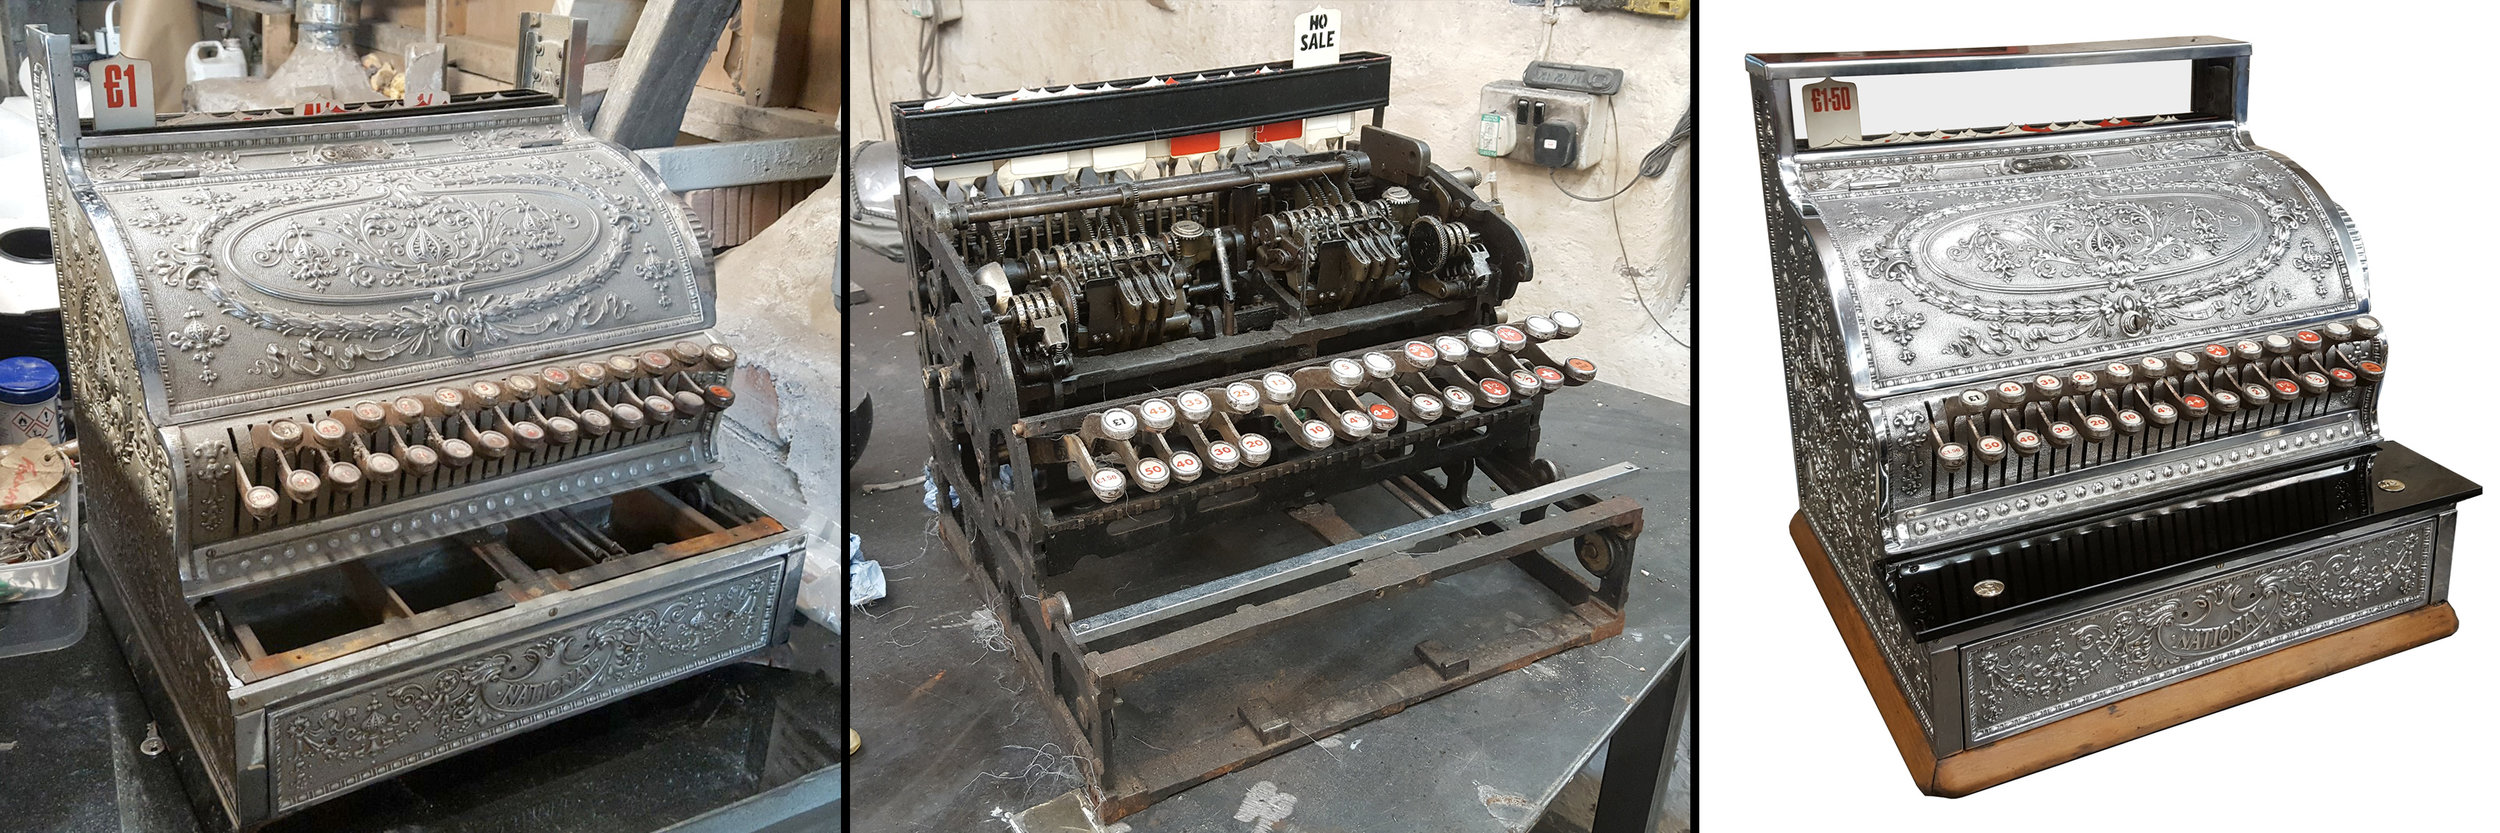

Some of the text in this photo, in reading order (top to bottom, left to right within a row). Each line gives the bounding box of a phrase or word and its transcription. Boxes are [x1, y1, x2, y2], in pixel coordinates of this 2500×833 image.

[1309, 14, 1328, 31] NO
[1300, 30, 1335, 51] SALE
[104, 64, 137, 108] £1
[1341, 363, 1350, 371] 5
[2074, 372, 2090, 381] 25
[1271, 378, 1287, 386] 15
[2039, 378, 2055, 386] 35
[1233, 389, 1250, 398] 25
[2003, 384, 2019, 393] 45
[440, 391, 457, 400] 15
[1968, 394, 1980, 402] £1
[1185, 397, 1203, 407] 35
[1149, 405, 1167, 415] 45
[1112, 417, 1127, 427] £1
[2123, 413, 2136, 421] 10
[2090, 418, 2106, 427] 20
[322, 424, 339, 434] 45
[1308, 425, 1324, 435] 10
[2054, 425, 2070, 434] 30
[1245, 439, 1263, 448] 20
[2019, 434, 2036, 444] 40
[1984, 441, 2000, 450] 50
[1214, 446, 1231, 456] 30
[1176, 458, 1194, 468] 40
[1144, 465, 1162, 476] 50
[2177, 605, 2267, 651] NATIONAL
[500, 658, 600, 707] NATIONAL
